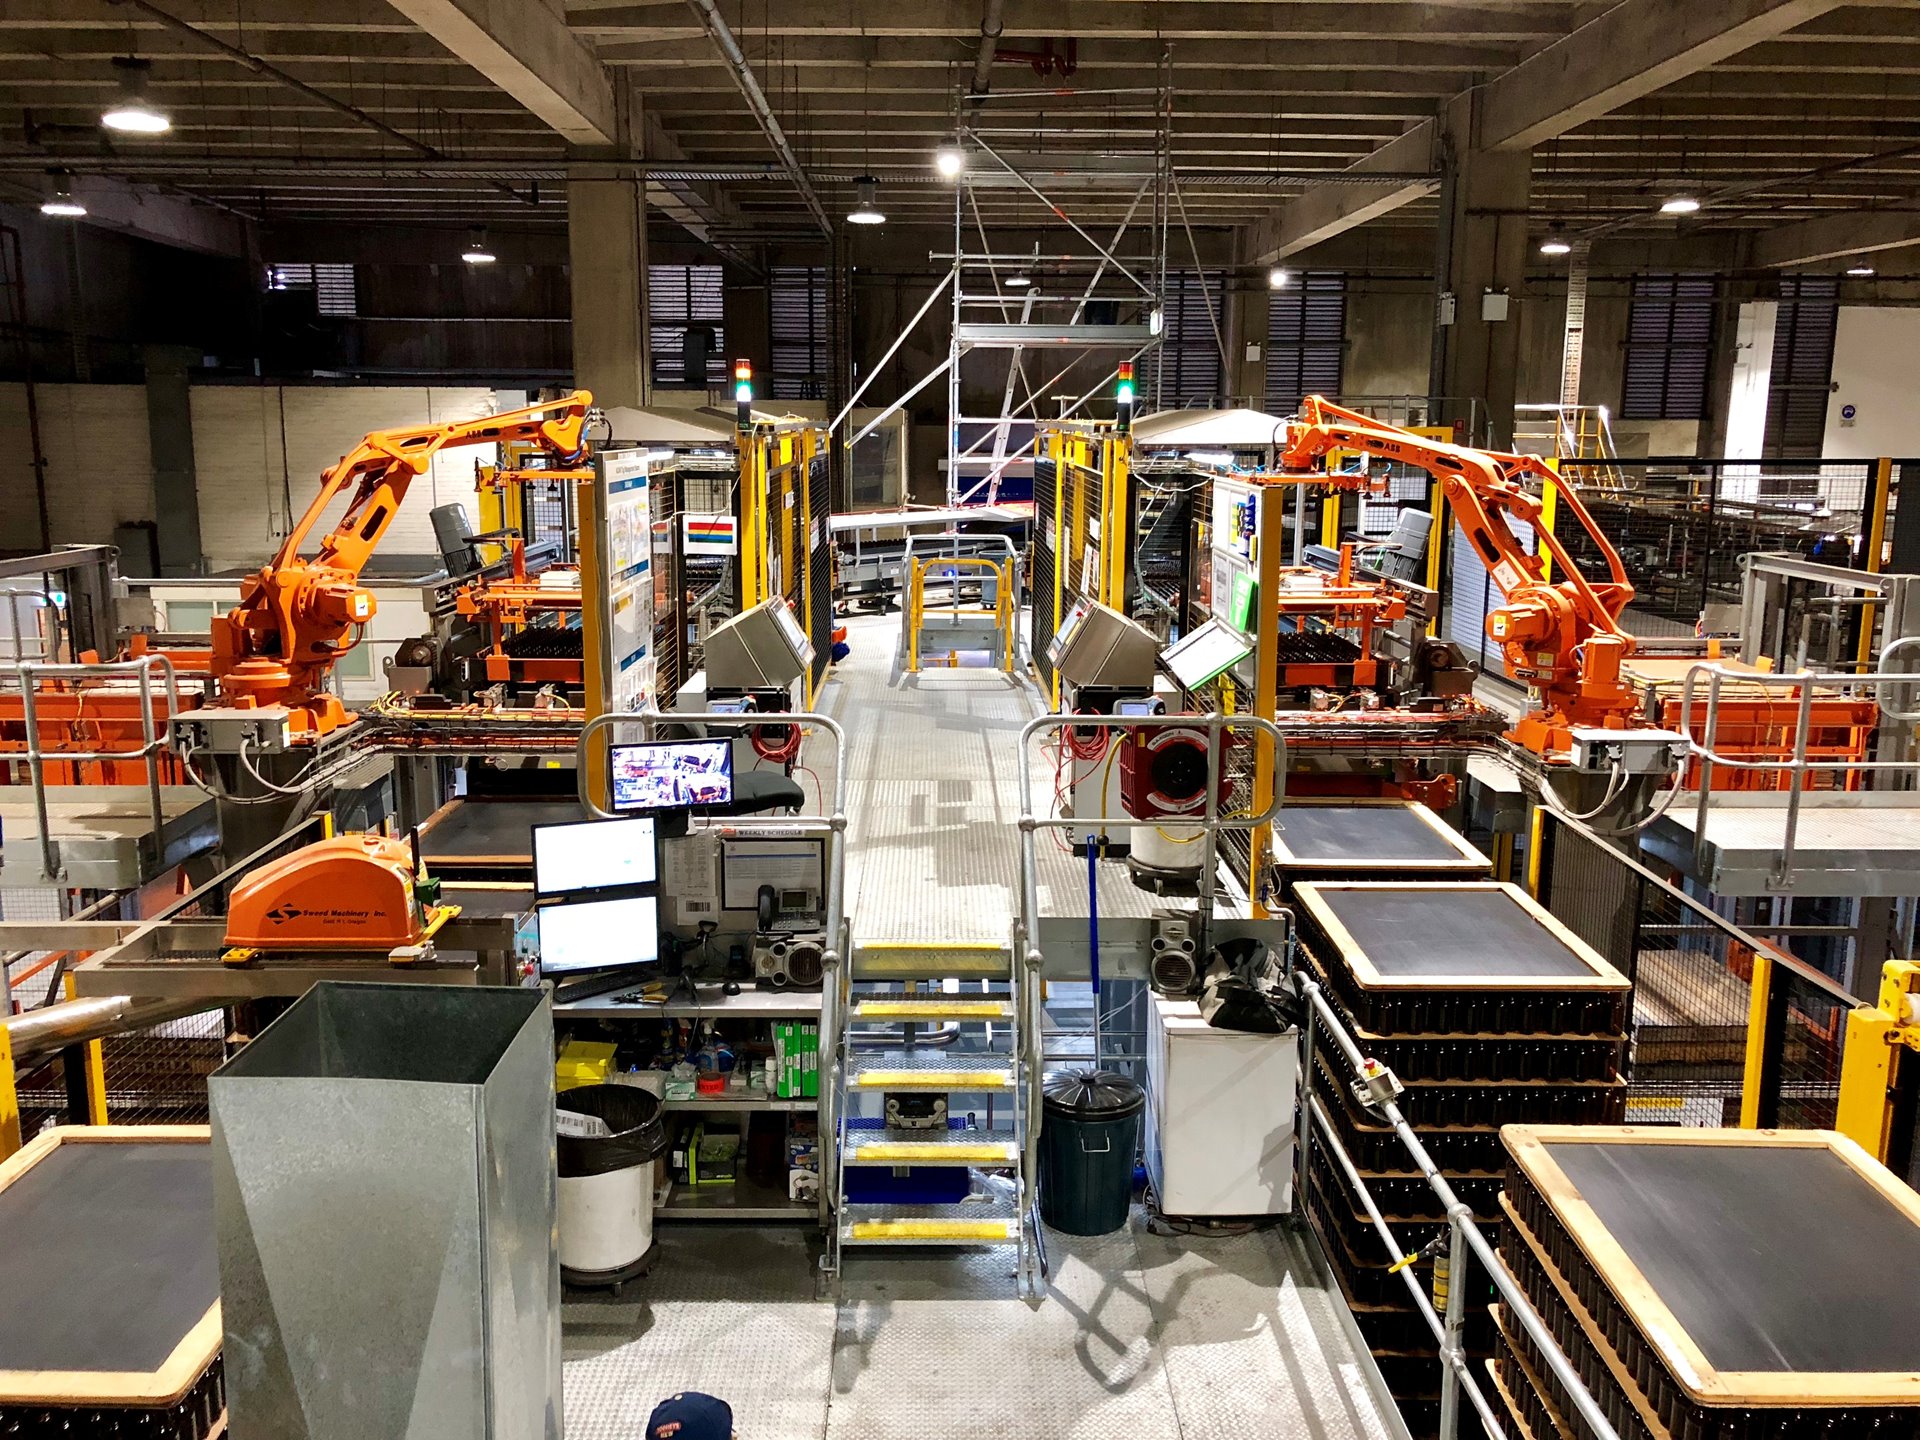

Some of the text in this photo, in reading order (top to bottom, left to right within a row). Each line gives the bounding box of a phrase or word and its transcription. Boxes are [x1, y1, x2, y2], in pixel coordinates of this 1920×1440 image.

[465, 430, 482, 439] ABB
[1384, 442, 1401, 453] ABB
[303, 909, 387, 918] Sweed Machinery Inc.
